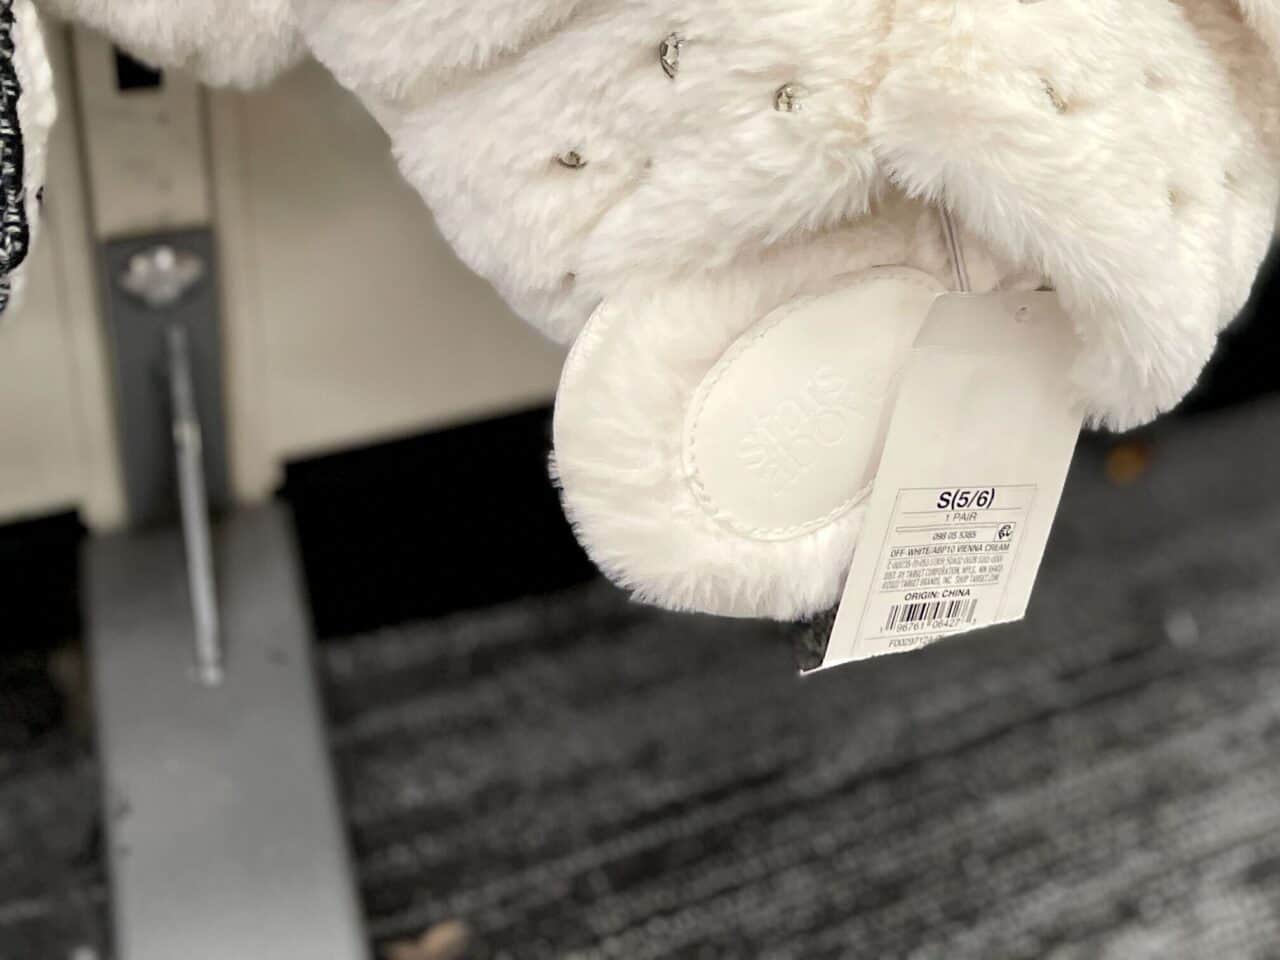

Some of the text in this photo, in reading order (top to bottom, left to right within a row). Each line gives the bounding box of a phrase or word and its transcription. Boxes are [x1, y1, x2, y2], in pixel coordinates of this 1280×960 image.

[936, 487, 995, 511] S(5/6)
[952, 511, 978, 522] PAIR
[957, 543, 983, 553] VIENNA
[984, 542, 1010, 552] CREAM
[904, 588, 971, 601] ORIGIN: CHINA
